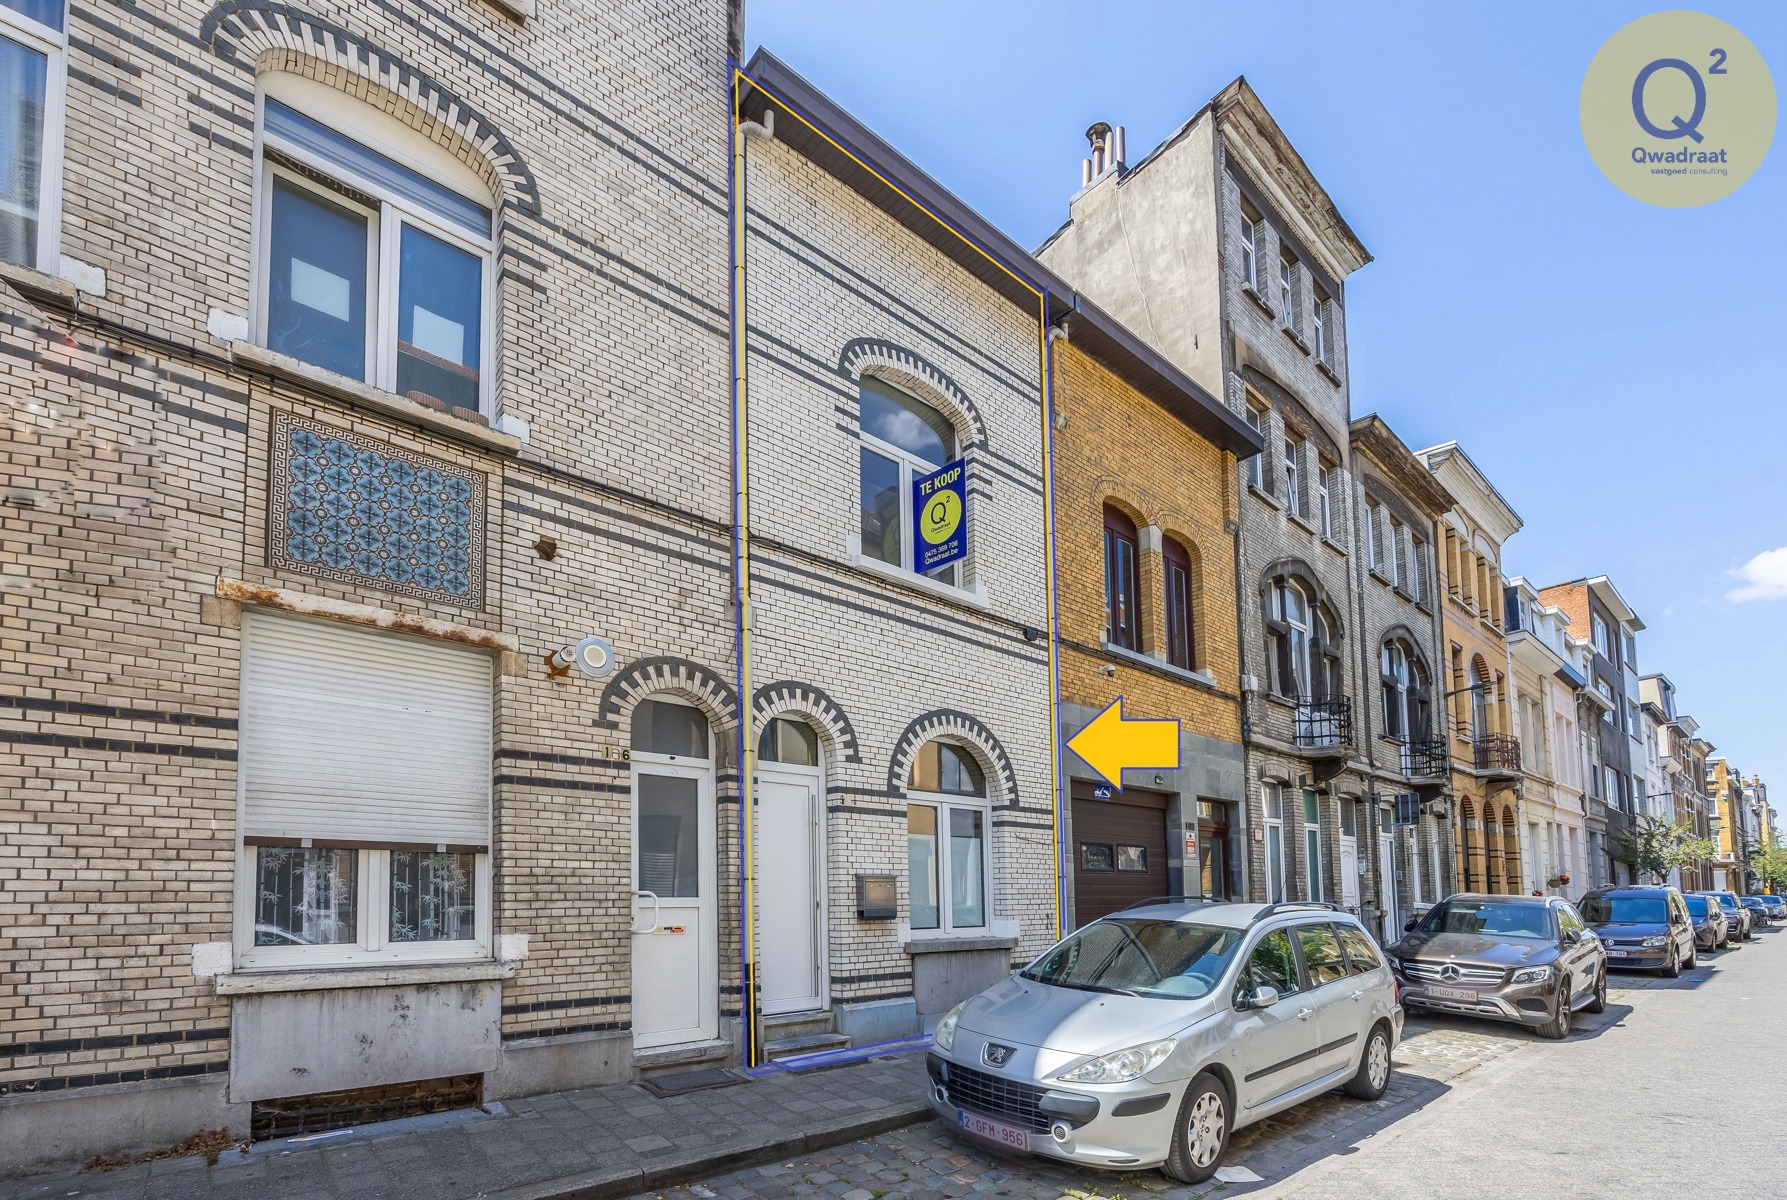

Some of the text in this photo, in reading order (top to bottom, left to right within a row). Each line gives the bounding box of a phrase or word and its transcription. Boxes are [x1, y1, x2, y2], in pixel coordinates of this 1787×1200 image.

[920, 467, 961, 496] TE KOOP
[924, 548, 958, 565] Qwadraat.be
[964, 1116, 1023, 1146] 2-GFM-956
